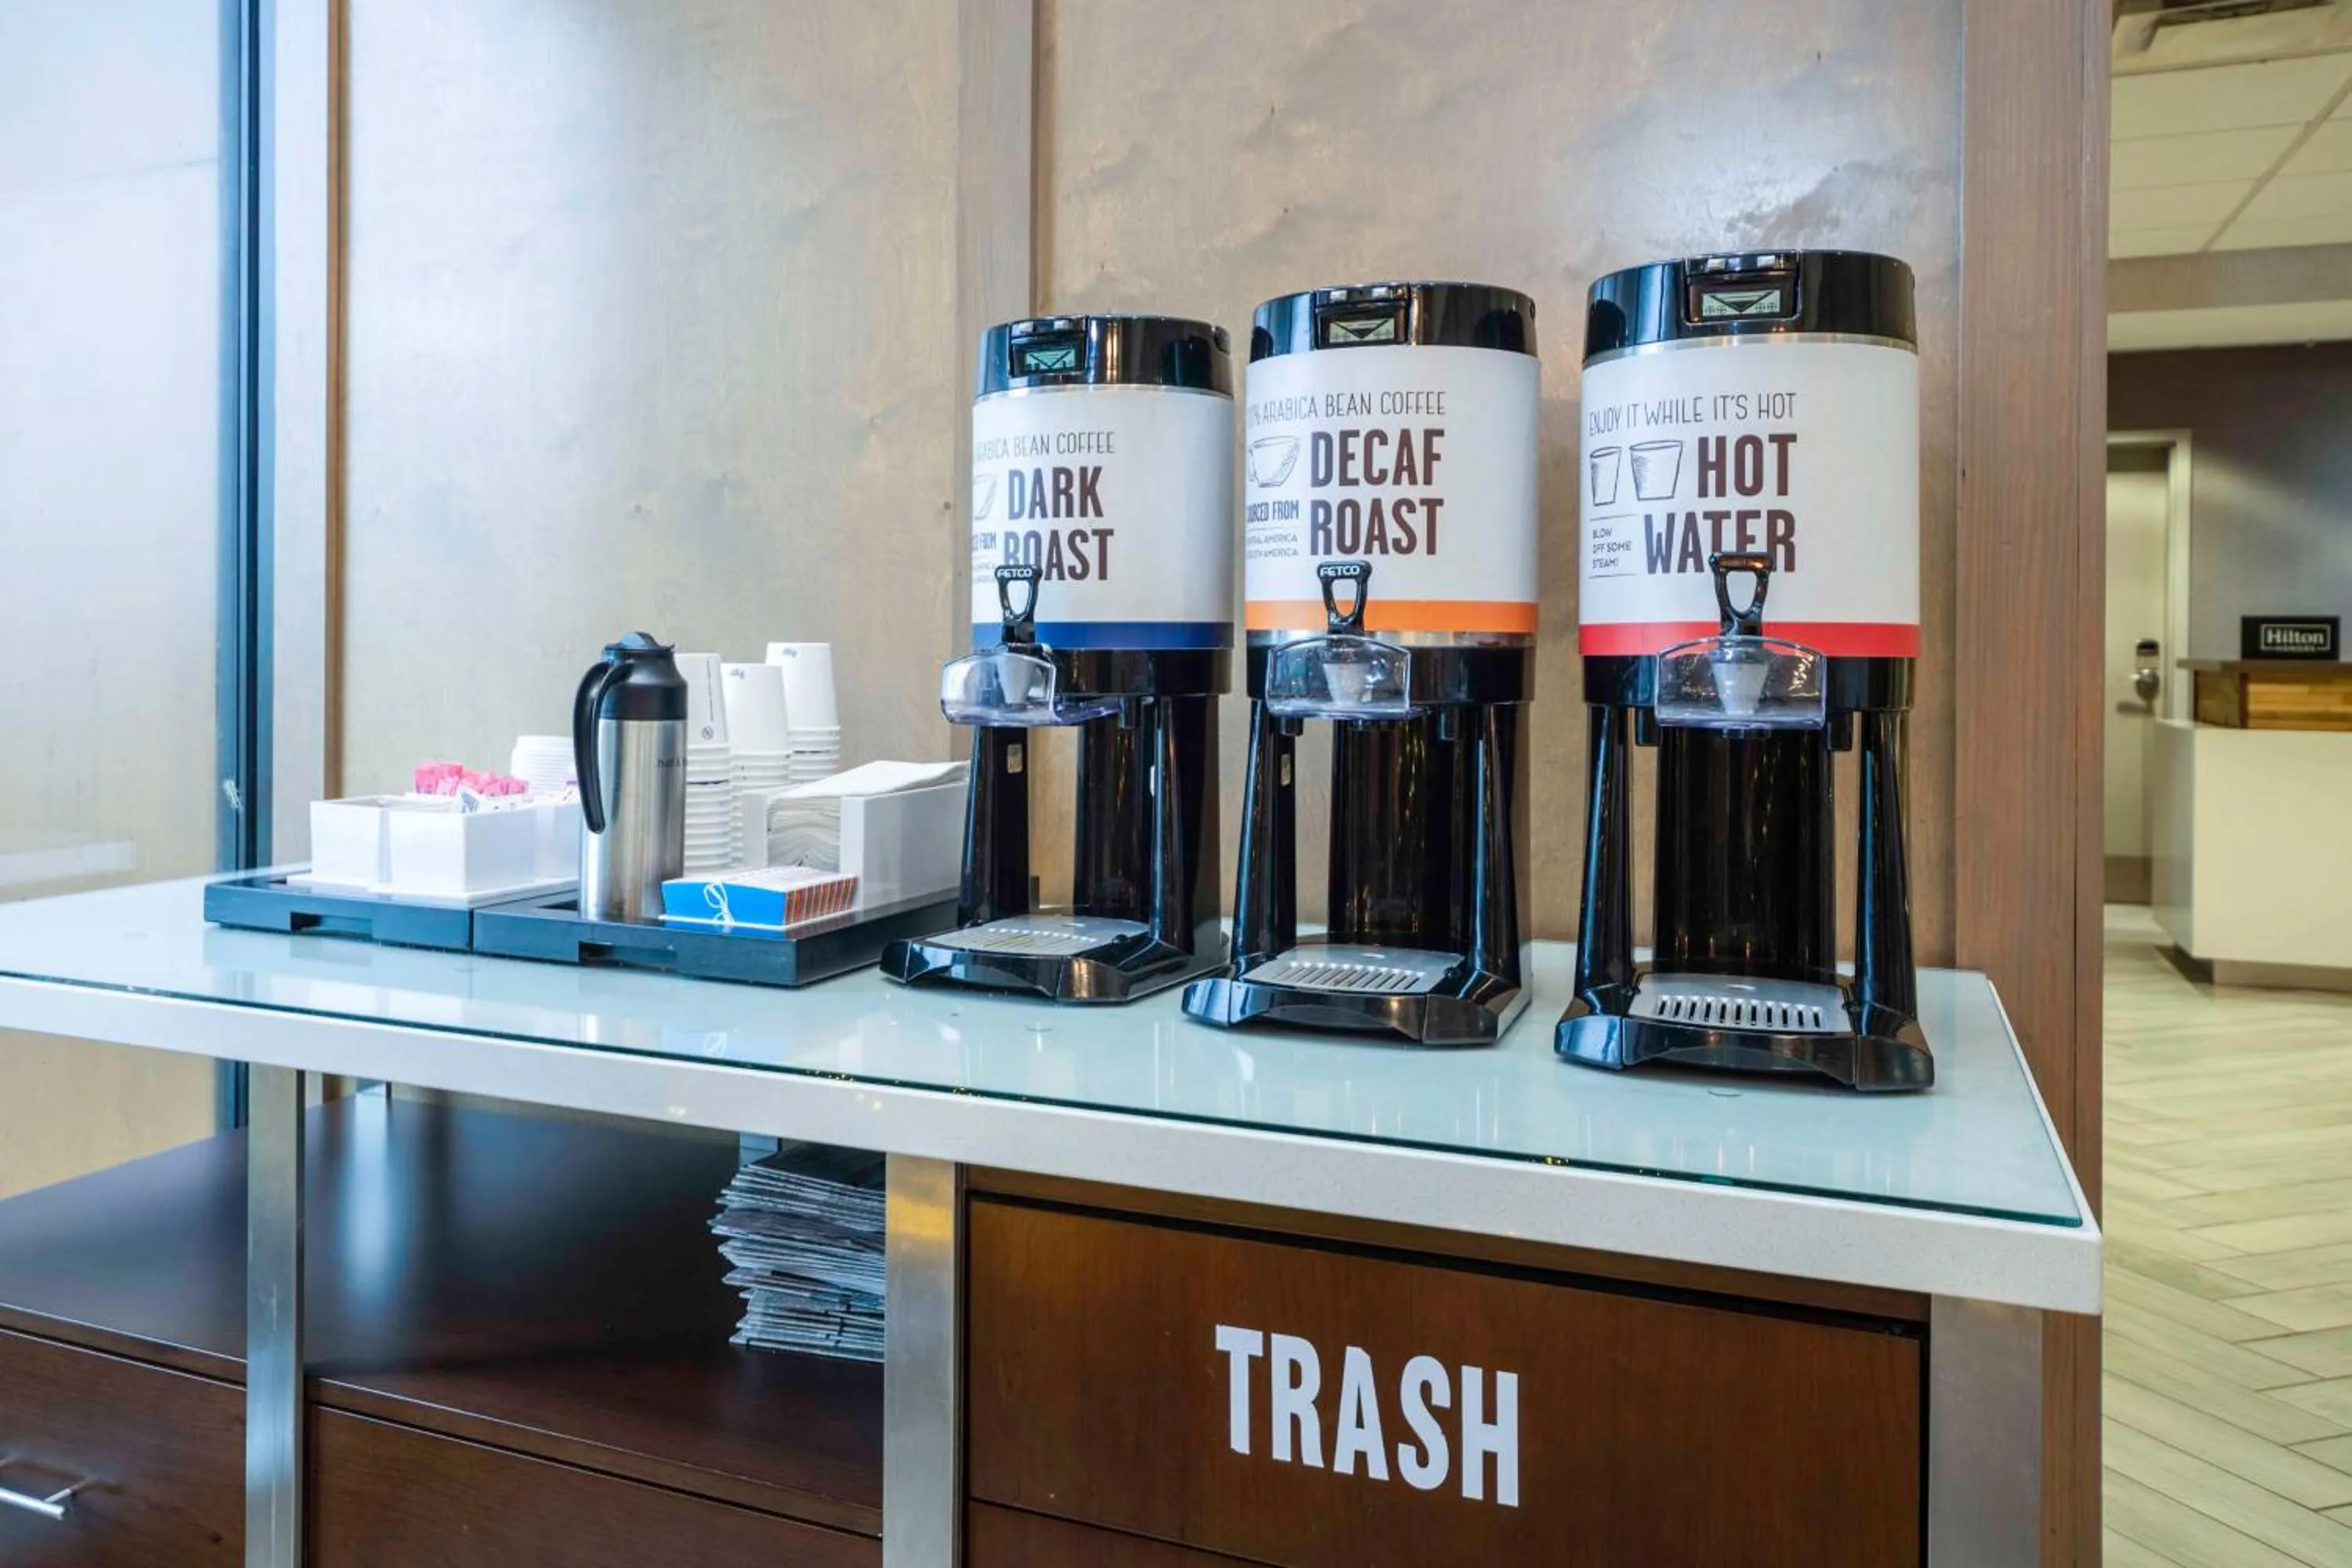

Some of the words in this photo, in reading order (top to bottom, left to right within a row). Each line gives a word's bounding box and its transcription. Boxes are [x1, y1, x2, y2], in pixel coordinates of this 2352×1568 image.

[1326, 392, 1372, 417] BEAN
[1380, 390, 1446, 416] COFFEE
[1589, 405, 1621, 436] ENJOY
[1627, 403, 1640, 428] IT
[1644, 395, 1704, 426] WHILE
[1713, 394, 1748, 421] IT'S
[1759, 392, 1797, 419] HOT
[1014, 433, 1051, 458] BEAN
[1056, 431, 1115, 454] COFFEE
[1310, 428, 1445, 488] DECAF
[1697, 434, 1797, 497] HOT
[1007, 466, 1104, 521] DARK
[1272, 499, 1299, 521] FROM
[1310, 497, 1445, 556] ROAST
[1606, 540, 1632, 552] SOME
[1644, 510, 1796, 574] WATER
[996, 567, 1033, 578] FETCO
[1004, 529, 1114, 581] ROAST
[1319, 564, 1360, 577] FETCO
[2267, 628, 2325, 644] Hilton
[1215, 1324, 1519, 1507] TRASH
